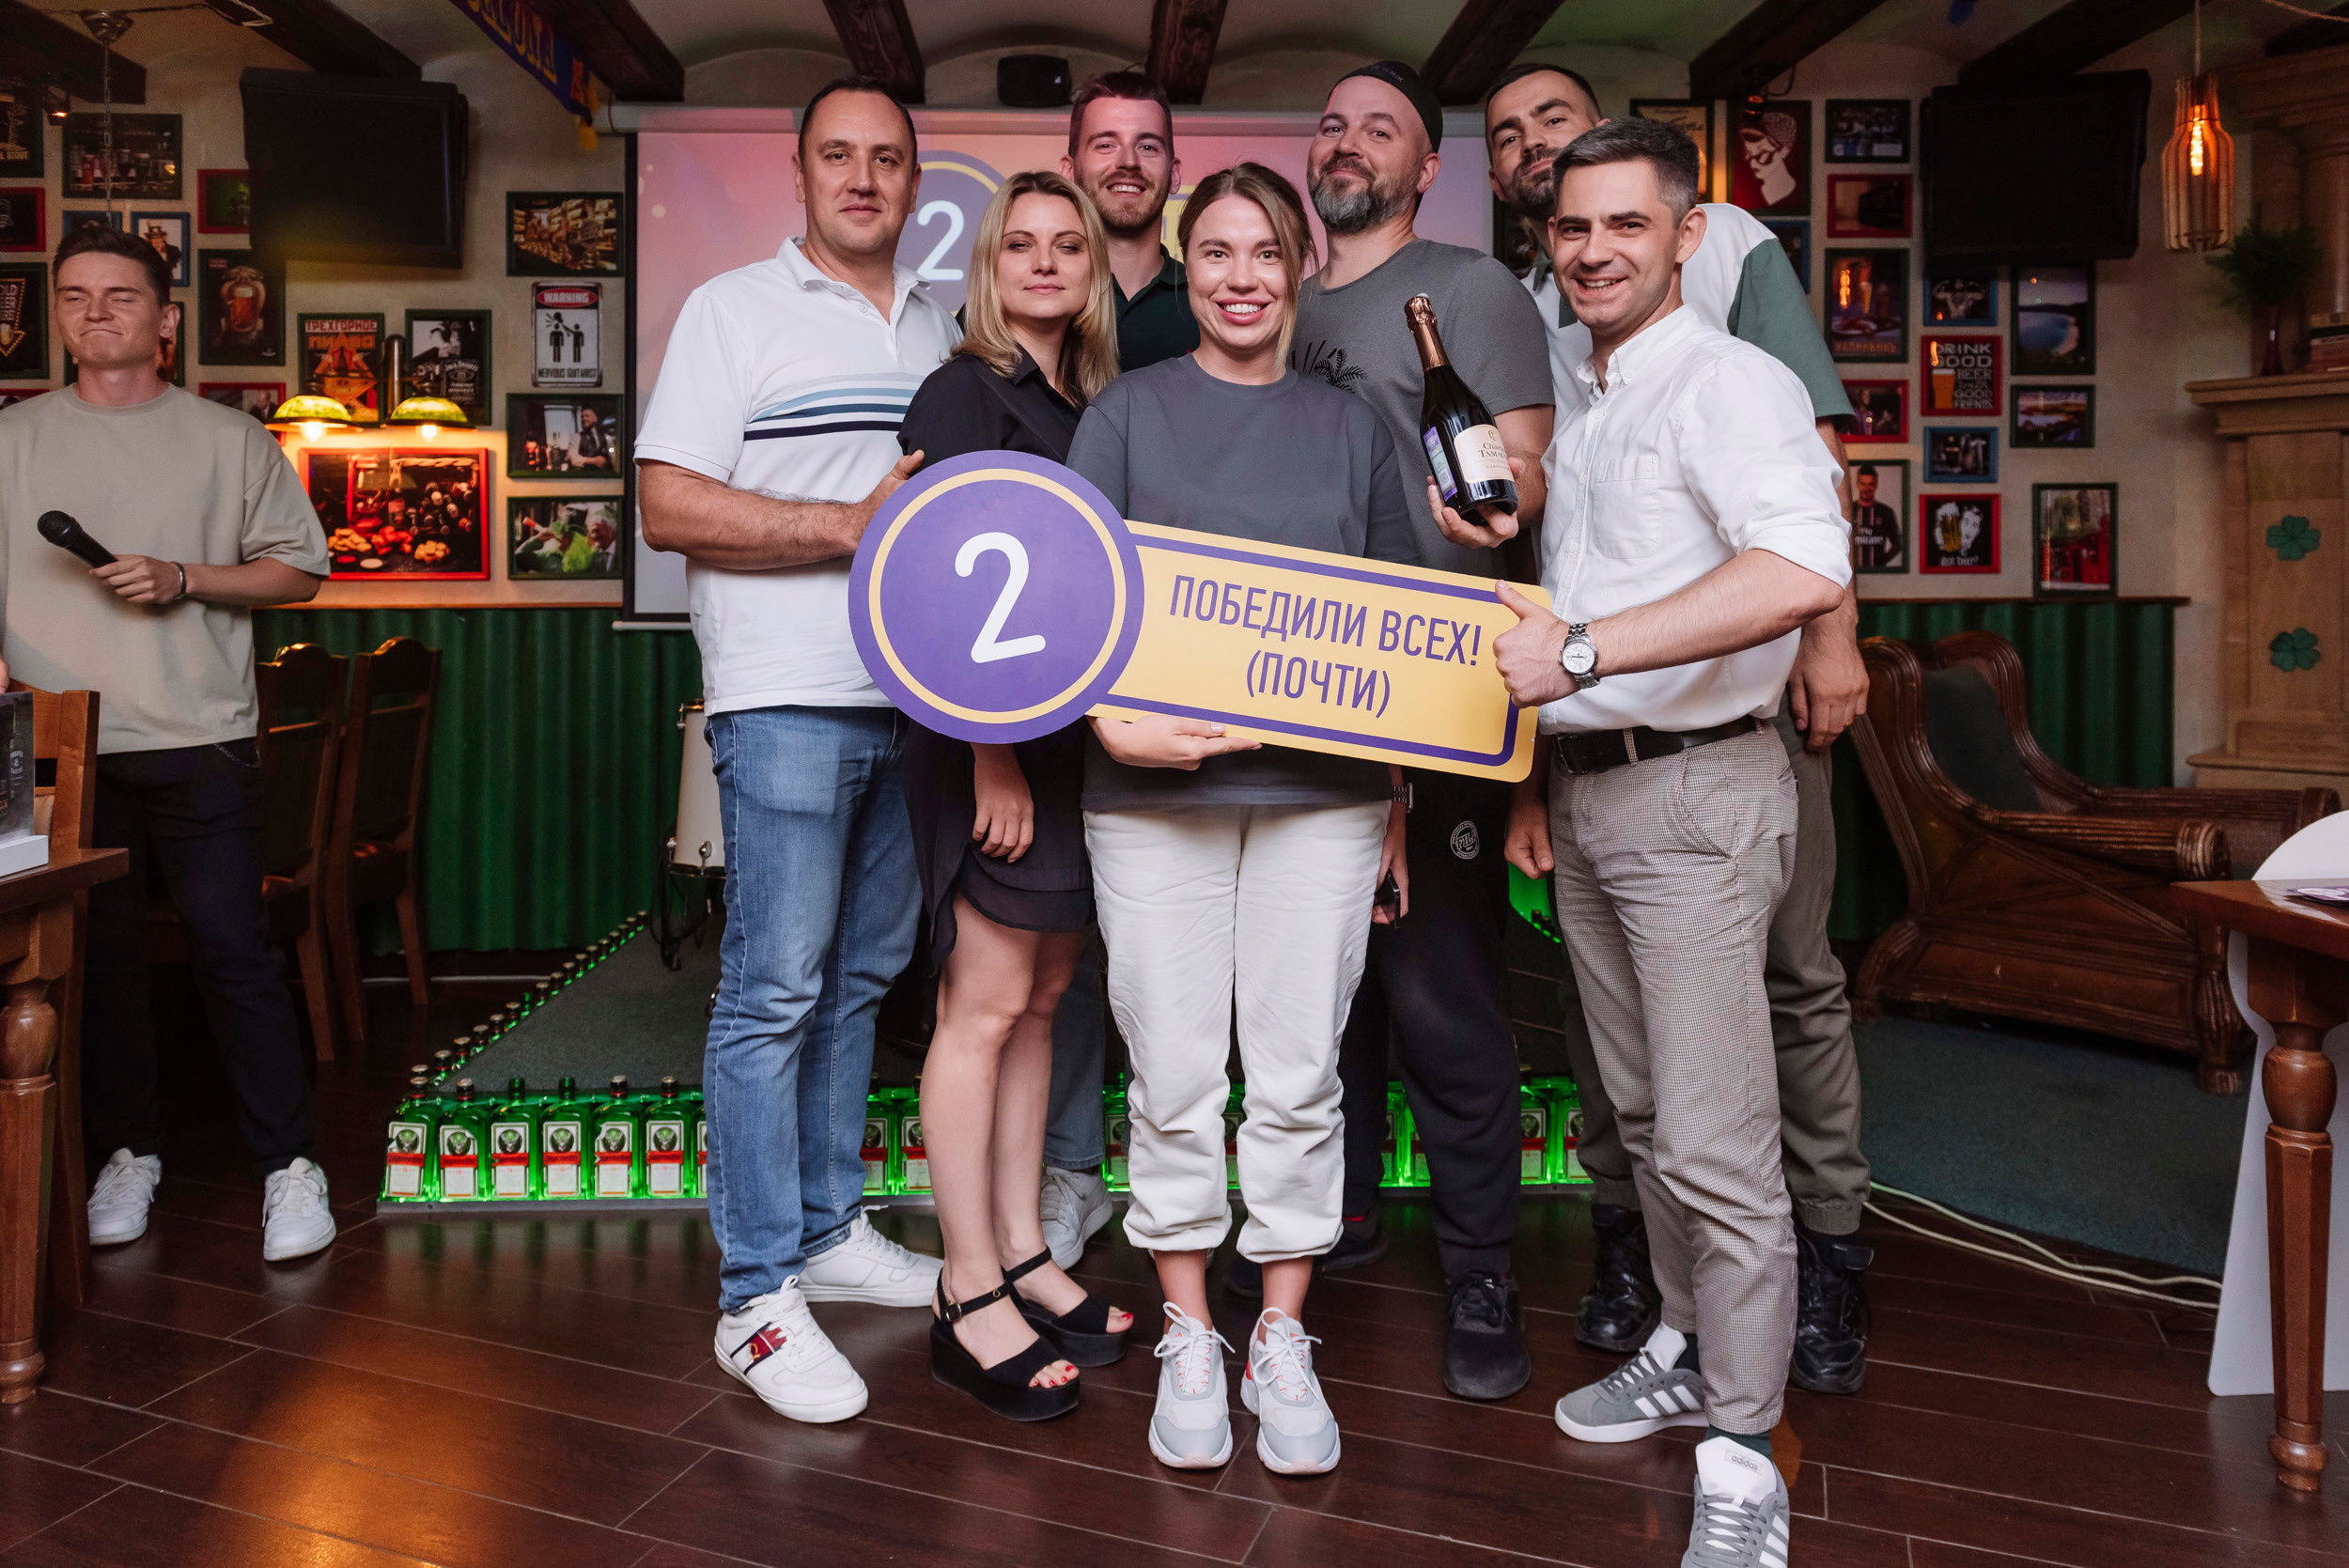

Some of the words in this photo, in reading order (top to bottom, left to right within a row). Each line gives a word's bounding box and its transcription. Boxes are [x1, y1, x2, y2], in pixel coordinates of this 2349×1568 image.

[917, 200, 965, 281] 2
[543, 292, 589, 303] WARNING
[1954, 389, 1994, 399] GOOD
[1957, 368, 1993, 380] BEER
[955, 532, 1047, 664] 2
[1170, 574, 1367, 647] ПОБЕДИЛИ
[1378, 610, 1482, 666] ВСЕХ!
[1246, 649, 1391, 719] (ПОЧТИ)
[1731, 1454, 1759, 1471] adidas
